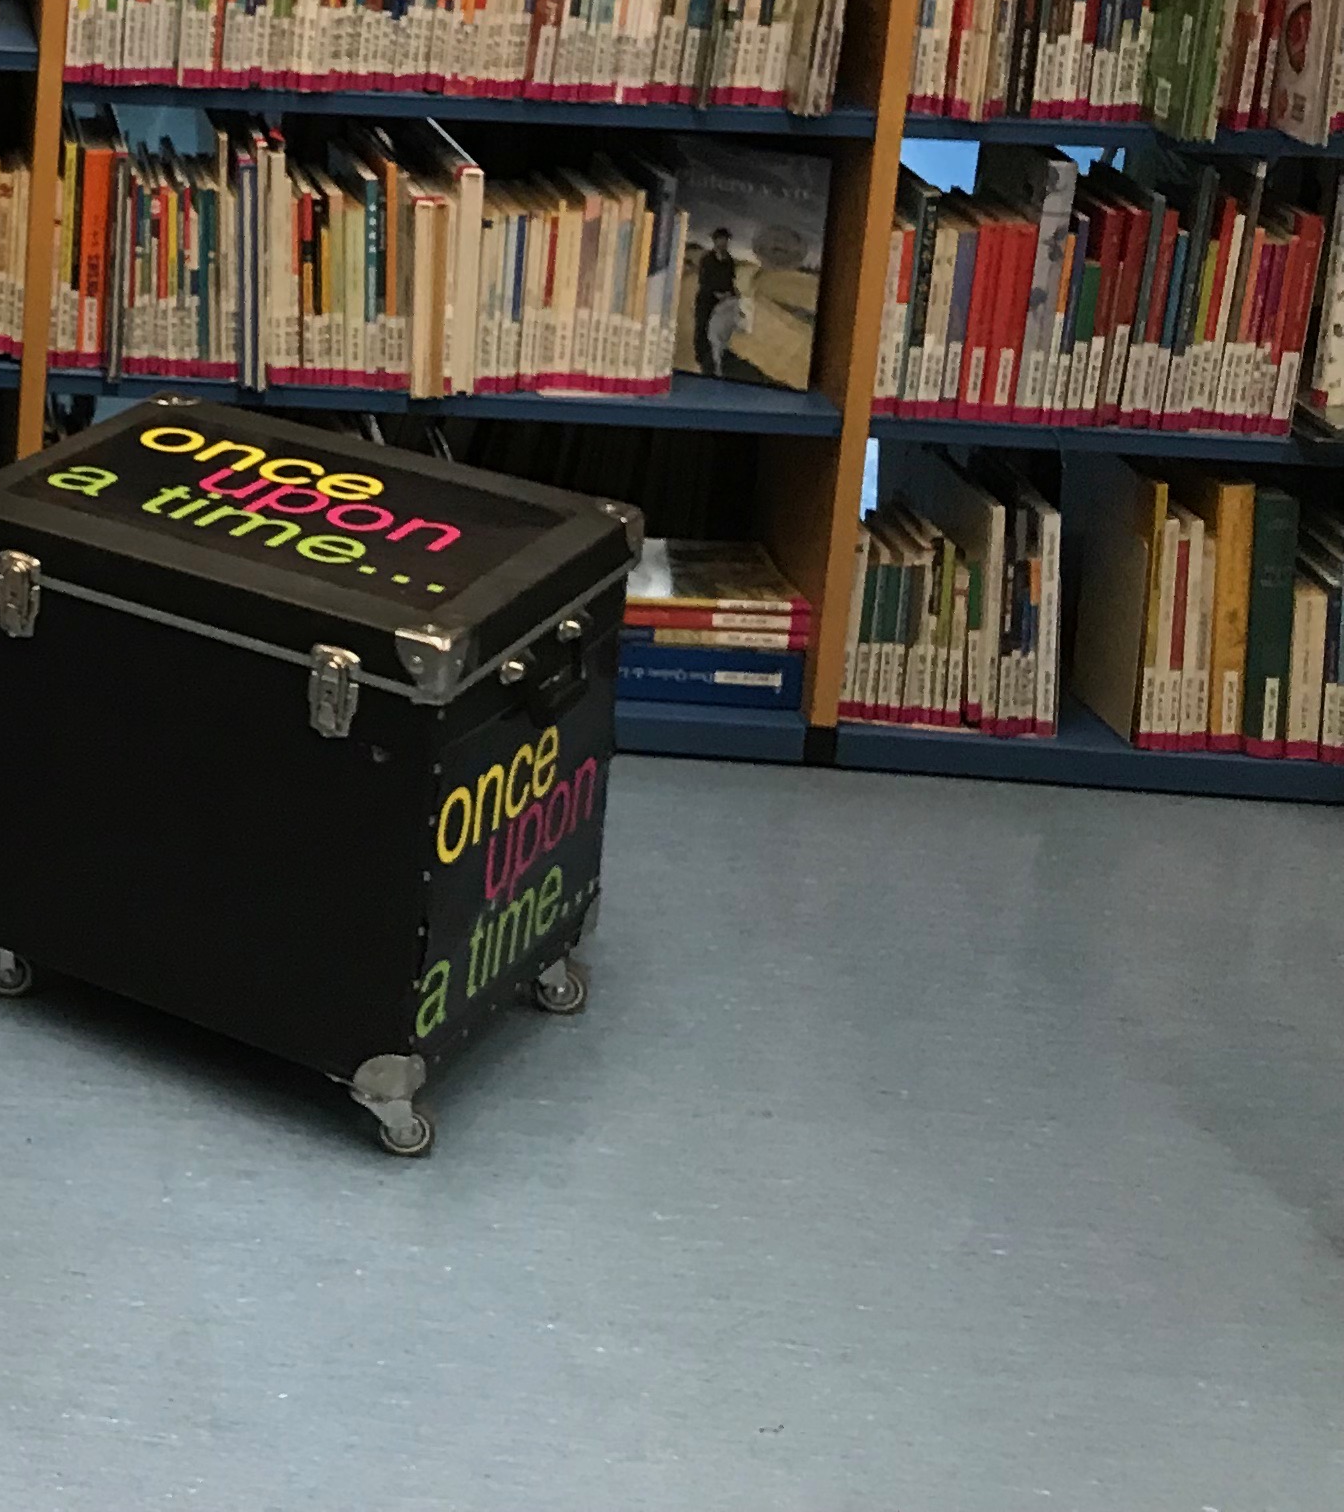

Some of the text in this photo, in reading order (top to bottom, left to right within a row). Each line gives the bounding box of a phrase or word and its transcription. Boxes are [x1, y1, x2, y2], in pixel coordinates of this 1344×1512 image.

[46, 465, 118, 497] a
[138, 425, 385, 501] once
[198, 468, 462, 552] upon
[437, 726, 558, 864] once
[484, 756, 599, 906] upon
[416, 959, 452, 1039] a
